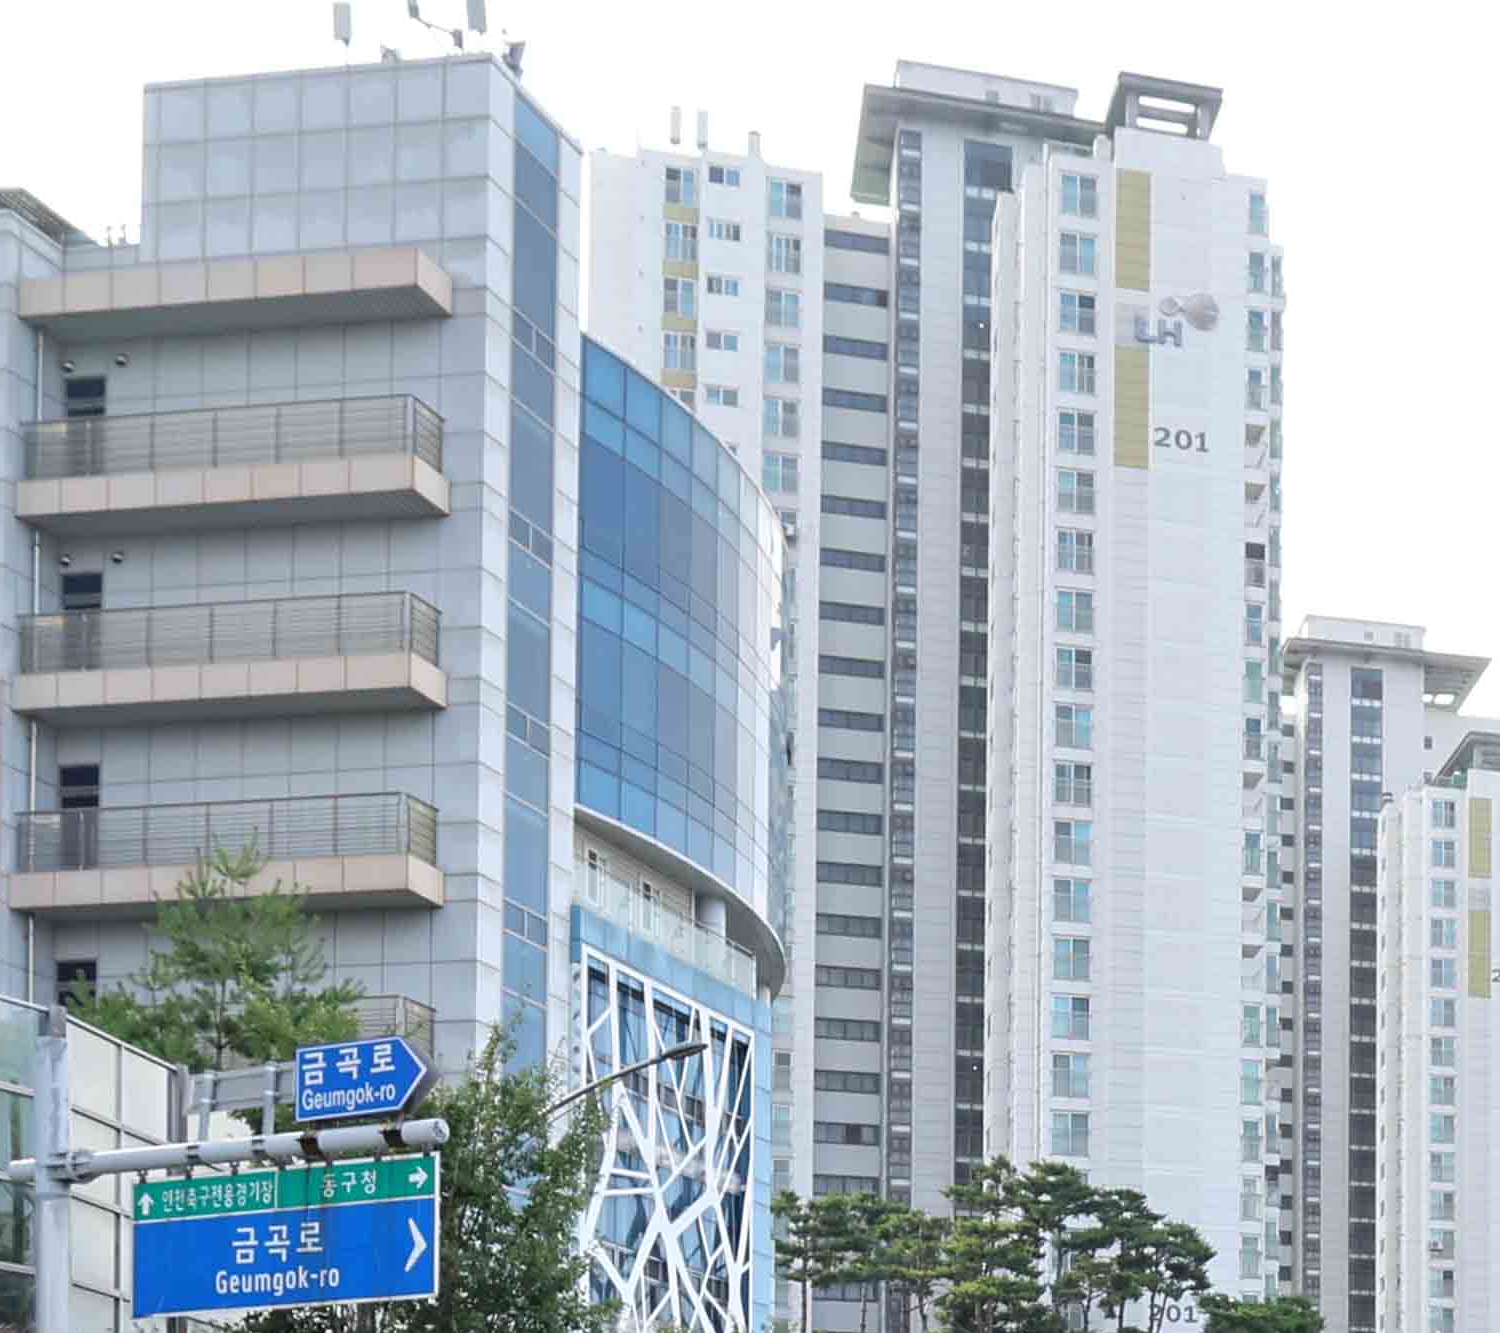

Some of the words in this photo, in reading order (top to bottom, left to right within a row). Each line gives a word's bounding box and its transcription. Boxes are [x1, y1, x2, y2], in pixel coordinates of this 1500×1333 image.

[1133, 314, 1184, 348] LH
[1152, 425, 1211, 454] 201
[301, 1044, 397, 1087] 금곡로
[301, 1081, 396, 1111] Geumgok-ro
[161, 1178, 274, 1213] 인천축구전용경기장
[321, 1168, 379, 1198] 동구청
[231, 1221, 325, 1265] 금곡로
[214, 1266, 341, 1298] Geumgok-ro
